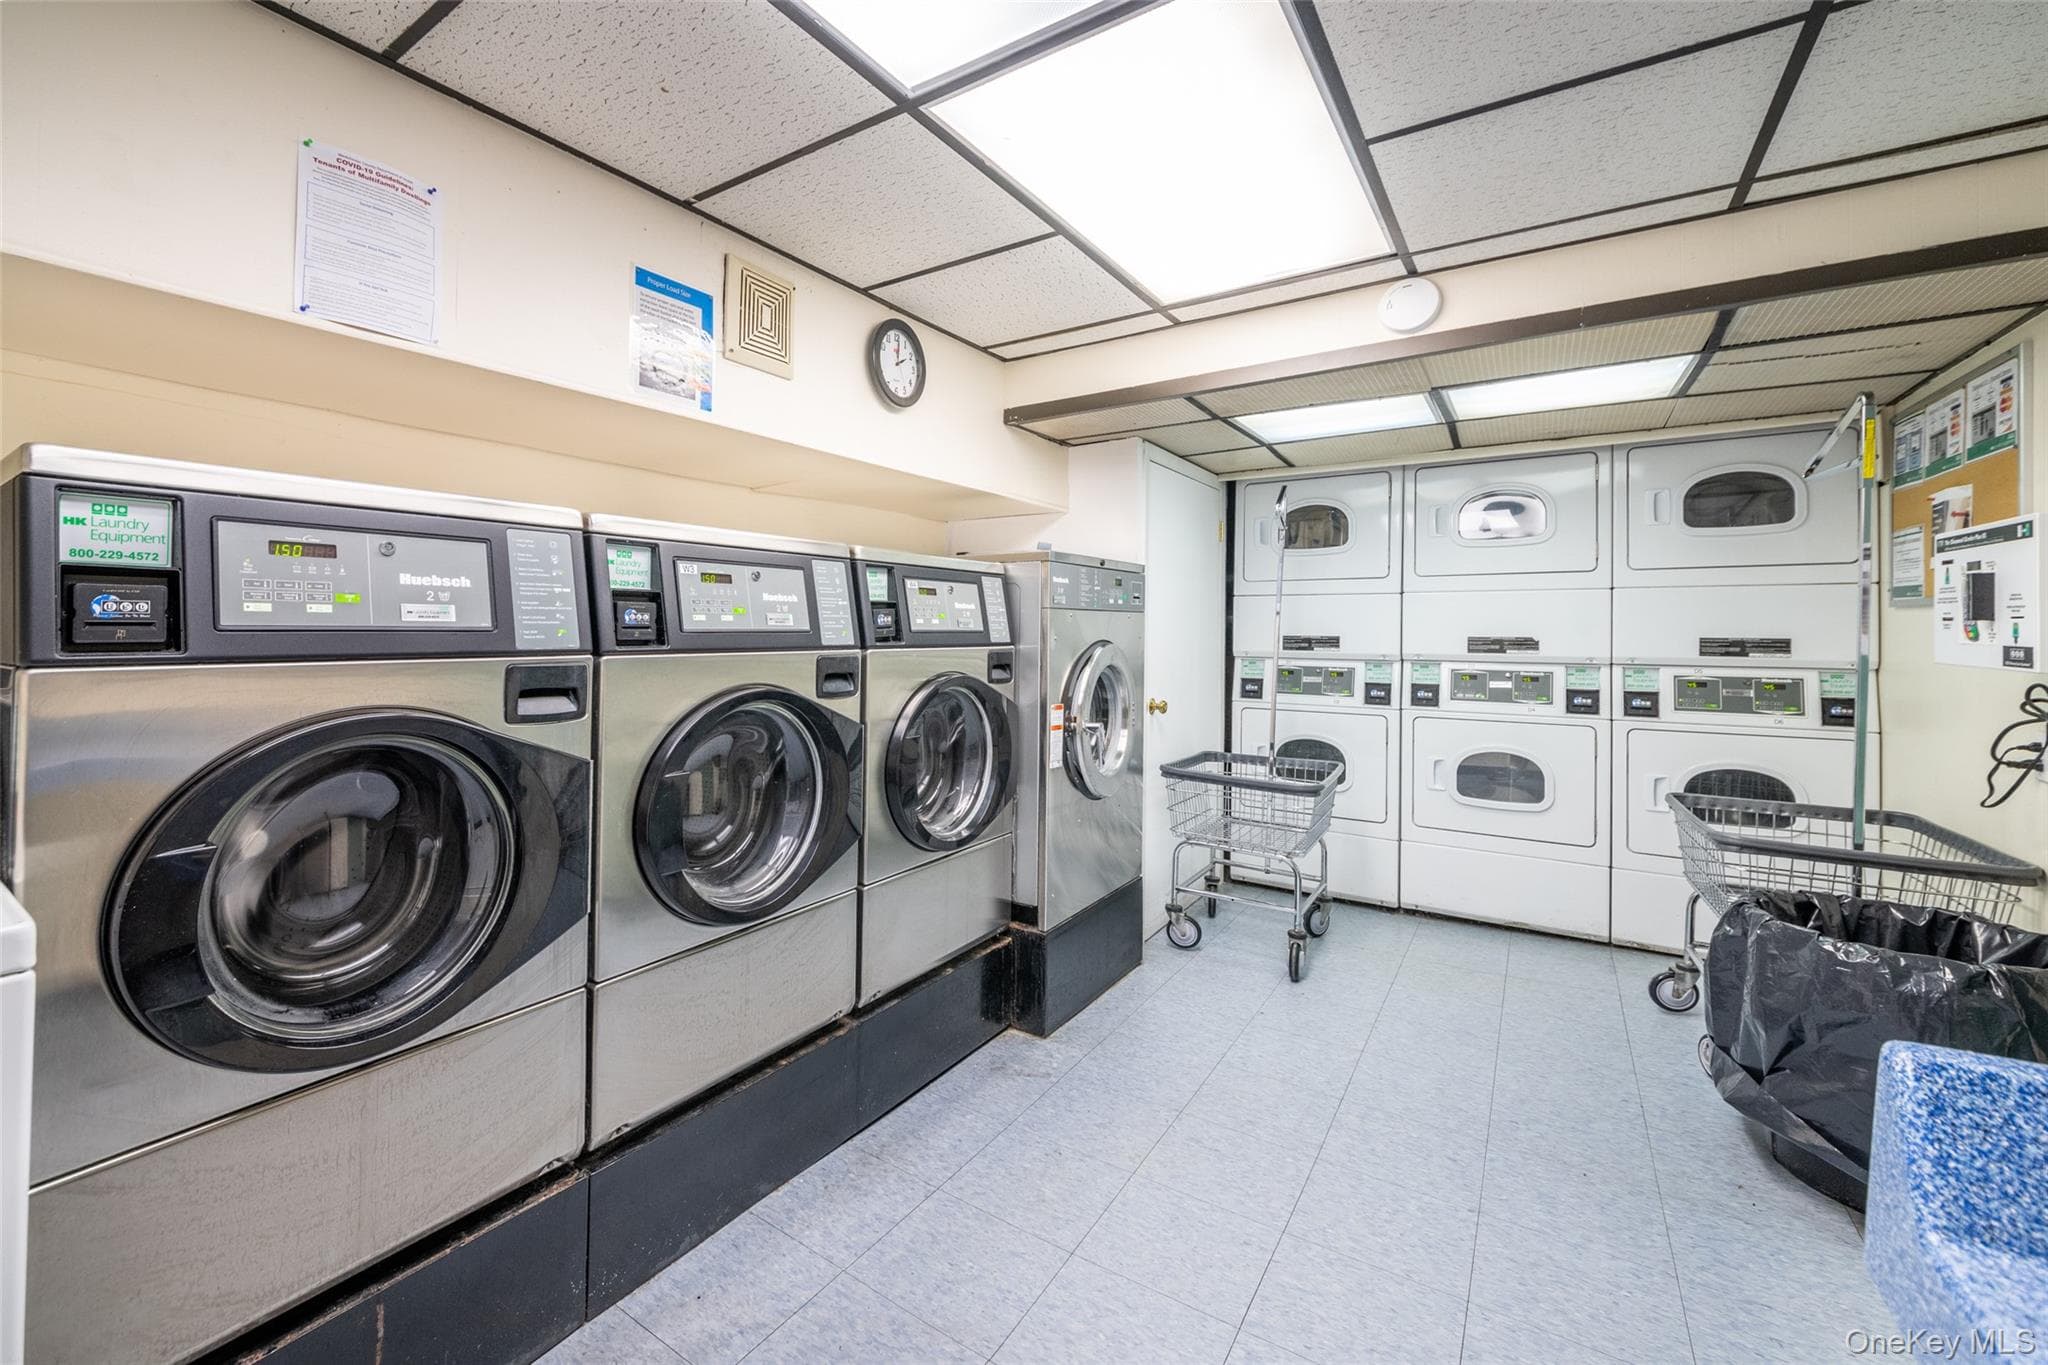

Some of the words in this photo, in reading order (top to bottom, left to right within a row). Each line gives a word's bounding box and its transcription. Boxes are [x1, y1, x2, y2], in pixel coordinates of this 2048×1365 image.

[336, 157, 374, 175] COVID-19
[312, 156, 346, 172] Tenants
[347, 168, 356, 176] of
[357, 171, 400, 192] Multifamily
[400, 187, 431, 207] Dwellings
[647, 276, 666, 289] Proper
[666, 283, 680, 295] Load
[680, 288, 692, 298] Size
[63, 516, 87, 526] HK
[91, 515, 150, 533] Laundry
[90, 529, 166, 545] Equipment
[68, 548, 159, 561] 800-229-4572
[616, 558, 642, 570] Laundry
[616, 566, 649, 577] Equipment
[682, 565, 695, 574] W3
[399, 573, 472, 588] Huebsch
[426, 590, 435, 601] 2
